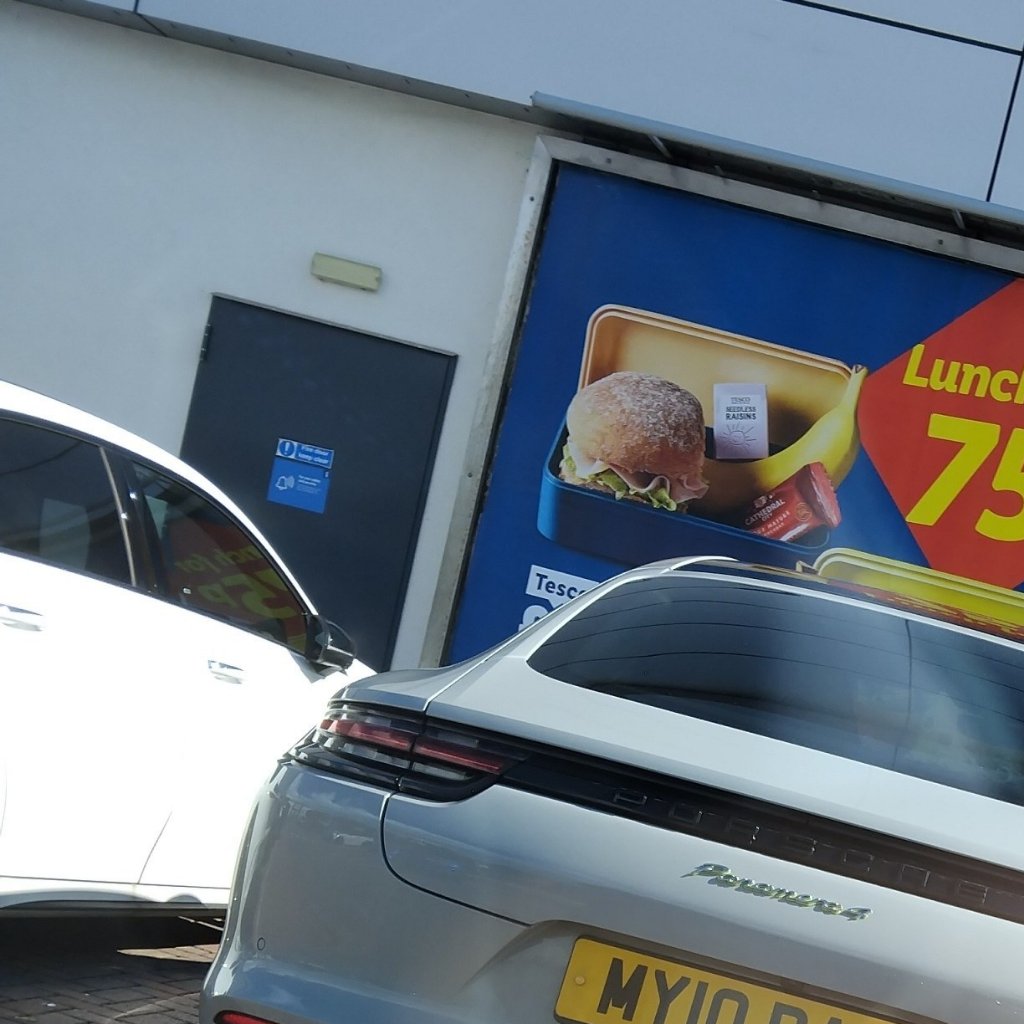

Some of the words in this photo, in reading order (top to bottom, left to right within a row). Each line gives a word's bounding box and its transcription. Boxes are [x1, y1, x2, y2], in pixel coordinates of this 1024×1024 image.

[725, 413, 757, 421] RAISINS
[745, 499, 786, 526] CATHEDRAL
[679, 862, 843, 916] Panamera
